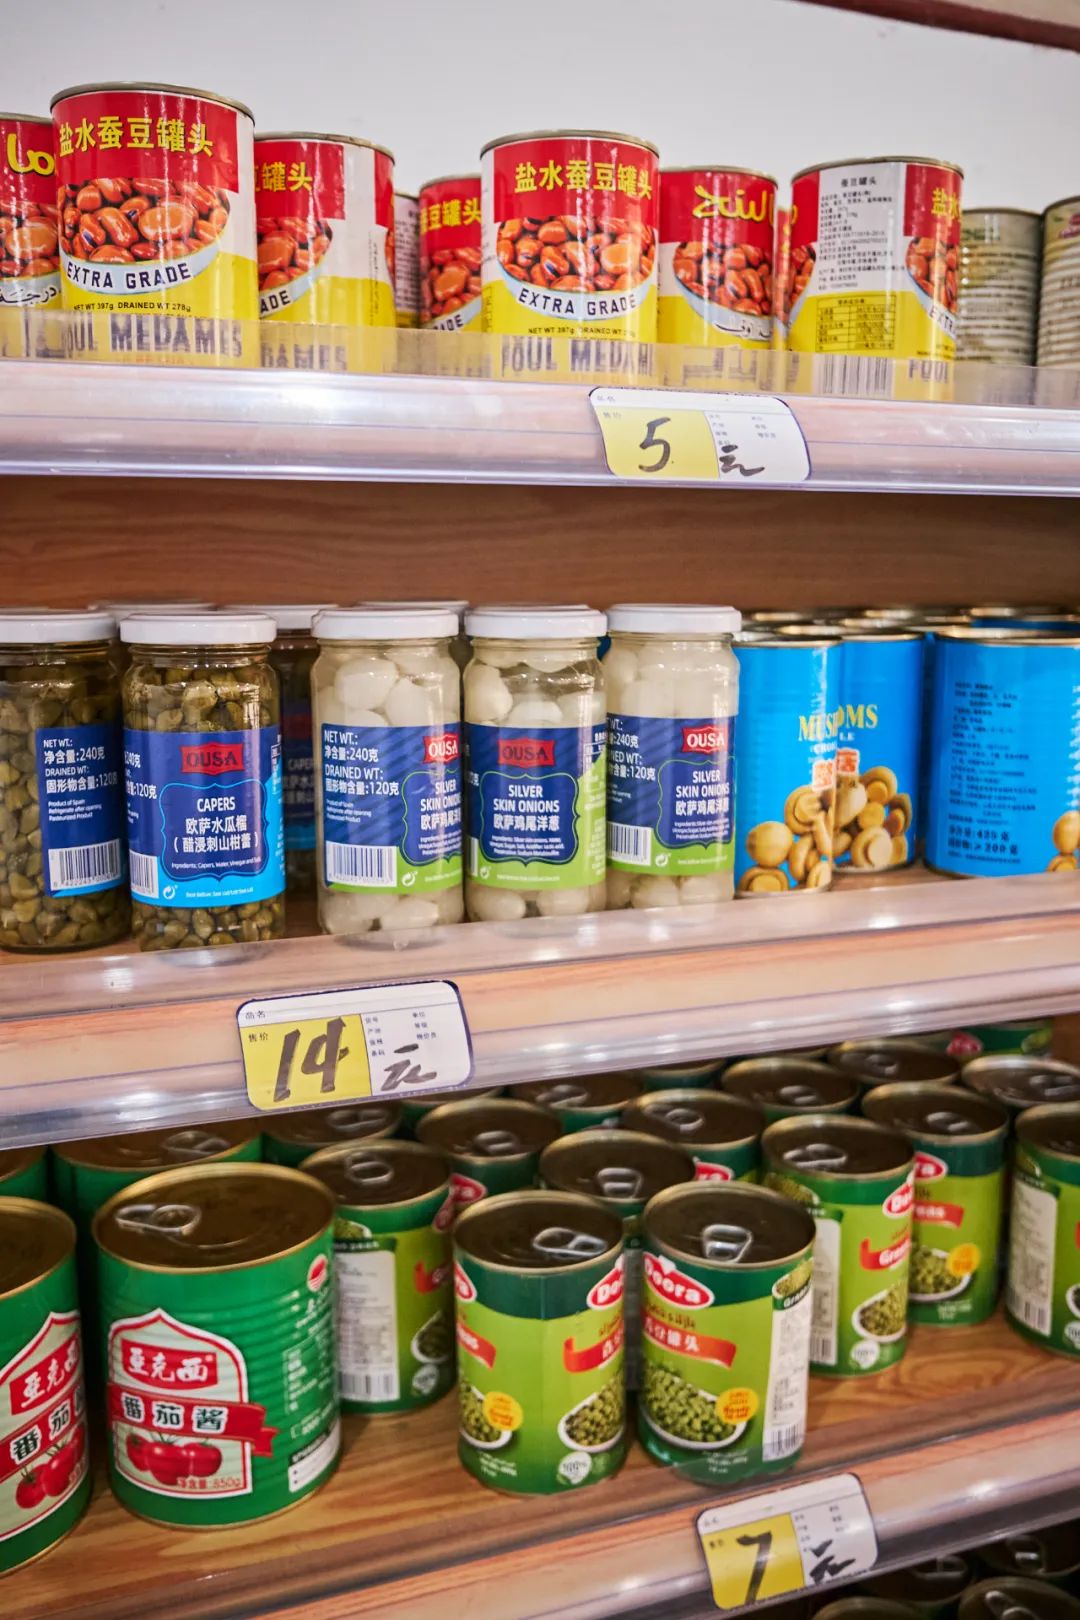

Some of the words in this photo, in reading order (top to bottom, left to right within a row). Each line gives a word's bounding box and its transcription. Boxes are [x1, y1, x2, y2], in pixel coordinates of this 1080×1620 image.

[59, 115, 214, 158] 盐水蚕豆罐头
[514, 159, 653, 201] 盐水蚕豆罐头
[67, 264, 114, 289] EXTRA
[126, 262, 193, 290] GRADE
[97, 302, 115, 313] 397g
[118, 301, 156, 310] DRAINED
[172, 303, 192, 313] 278g
[260, 289, 292, 314] ADE
[518, 288, 576, 315] EXTRA
[586, 292, 639, 316] GRADE
[638, 416, 672, 473] 5
[43, 739, 58, 749] NET
[324, 730, 339, 744] NET
[686, 732, 726, 748] OUSA
[324, 745, 379, 763] 净含量:240克
[428, 738, 459, 757] OUSA
[502, 745, 549, 762] OUSA
[185, 750, 239, 769] OUSA
[45, 766, 76, 777] DRAINED
[324, 763, 362, 780] DRAINED
[692, 769, 721, 785] SILVER
[435, 779, 457, 796] SILVER
[508, 784, 544, 799] SILVER
[675, 785, 700, 799] SKIN
[701, 781, 730, 797] ONIONS
[197, 796, 236, 813] CAPERS
[420, 797, 442, 812] SKIN
[493, 798, 516, 812] SKIN
[518, 799, 561, 814] ONIONS
[185, 815, 248, 836] 欧萨水瓜榴
[493, 814, 561, 833] 欧萨鸡尾洋葱
[248, 1032, 269, 1043] 售价
[272, 1016, 350, 1103] 14
[120, 1392, 229, 1435] 番茄酱
[736, 1530, 773, 1605] 7
